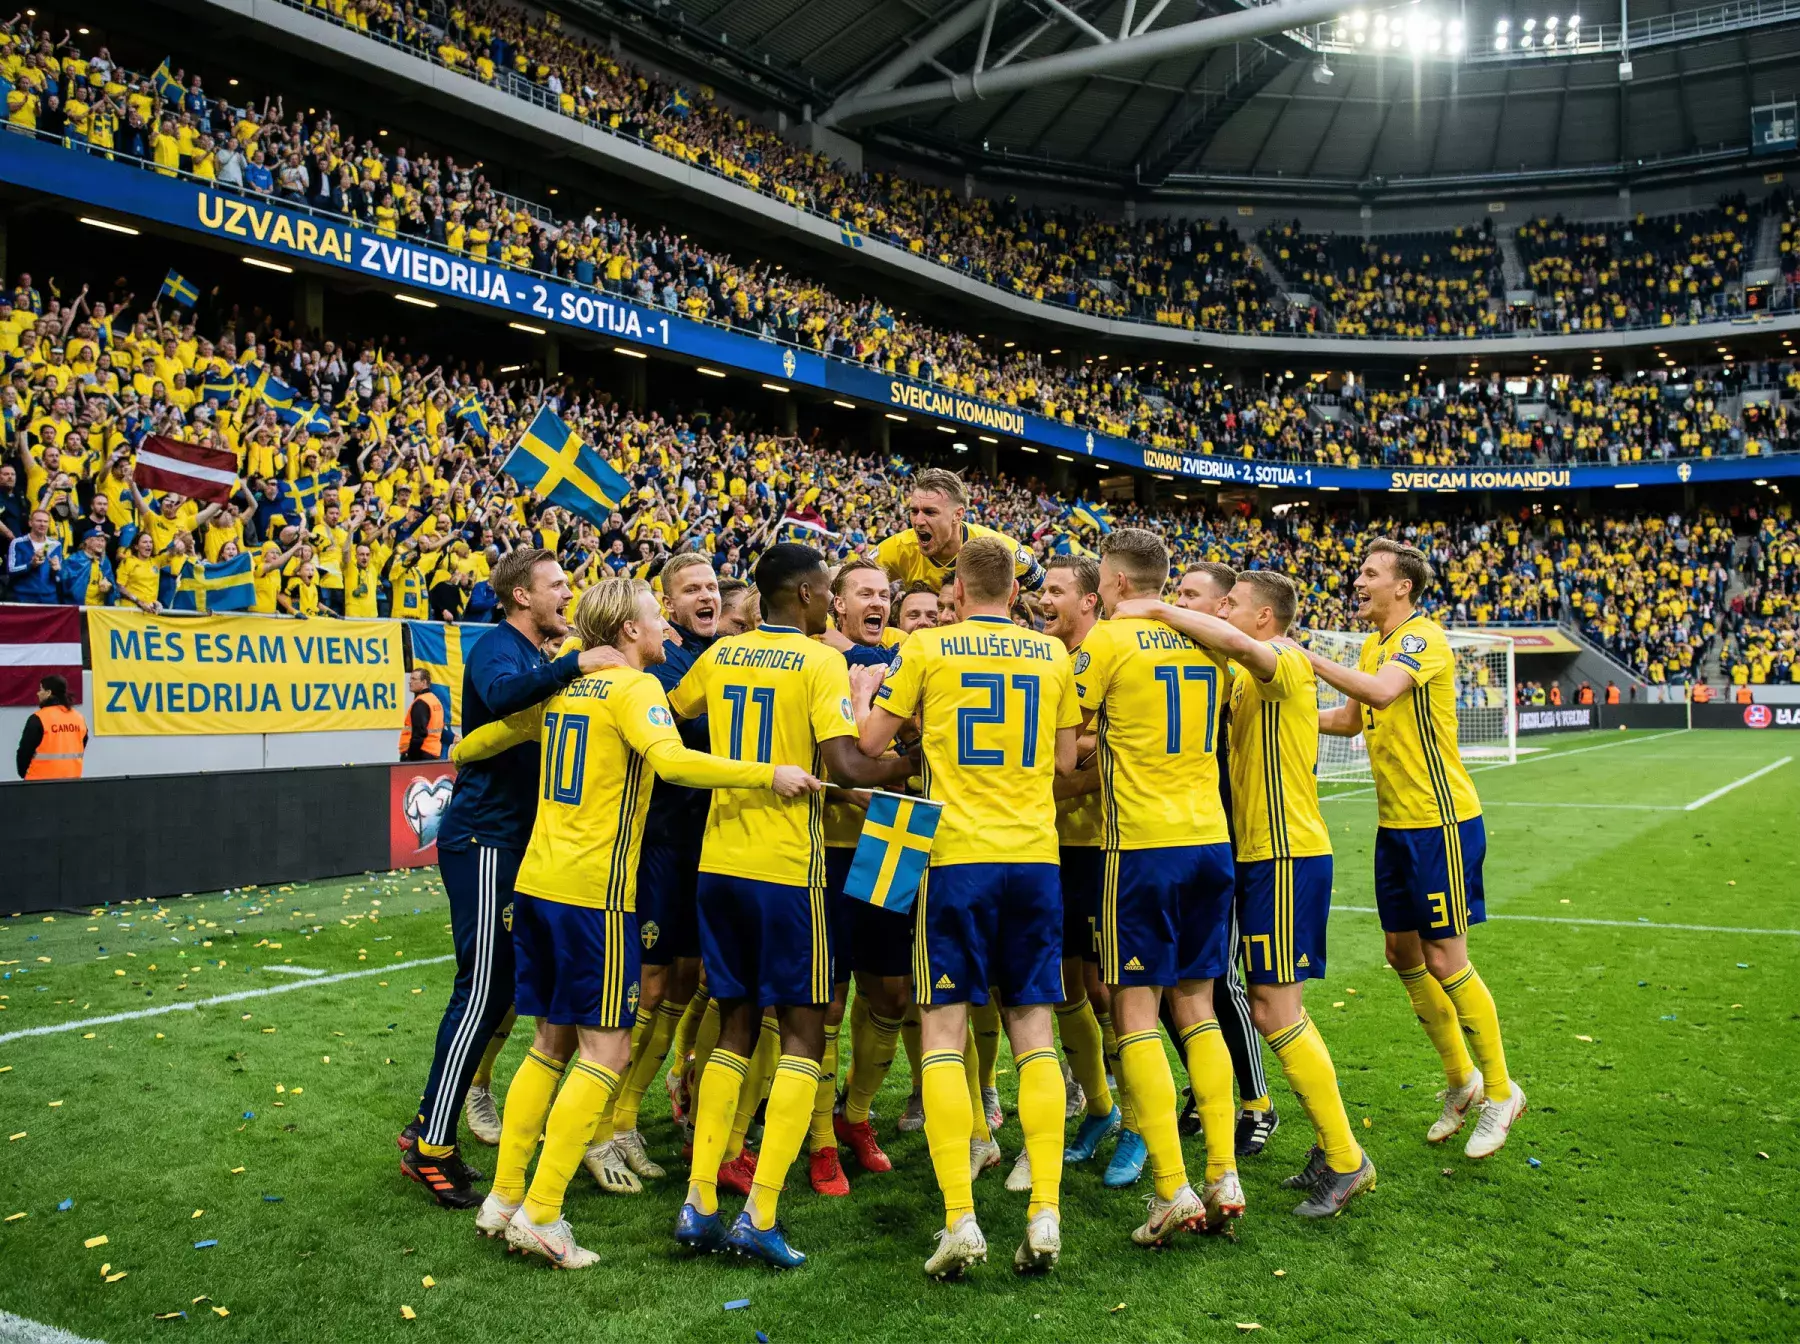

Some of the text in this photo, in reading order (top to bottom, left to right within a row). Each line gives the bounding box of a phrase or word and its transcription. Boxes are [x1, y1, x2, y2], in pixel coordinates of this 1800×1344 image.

[198, 192, 352, 263] UZVARA!
[360, 237, 511, 304] ZVIEDRIJA
[532, 285, 554, 319] 2,
[560, 292, 642, 338] SOTIJA
[659, 319, 669, 344] 1
[890, 381, 1024, 435] SVEICAM KOMANDU!
[1143, 449, 1182, 472] UZVARA!
[1243, 464, 1254, 483] 2,
[1304, 469, 1312, 485] 1
[1391, 470, 1571, 488] SVEICAM KOMANDU!
[109, 625, 390, 665] MĒS ESAM VIENS!
[105, 680, 397, 713] ZVIEDRIJA UZVAR!
[957, 672, 1040, 768] 21
[1154, 665, 1217, 754] 17
[723, 684, 776, 764] 11
[543, 711, 590, 807] 10
[1426, 891, 1450, 929] 3
[1242, 933, 1273, 972] 17
